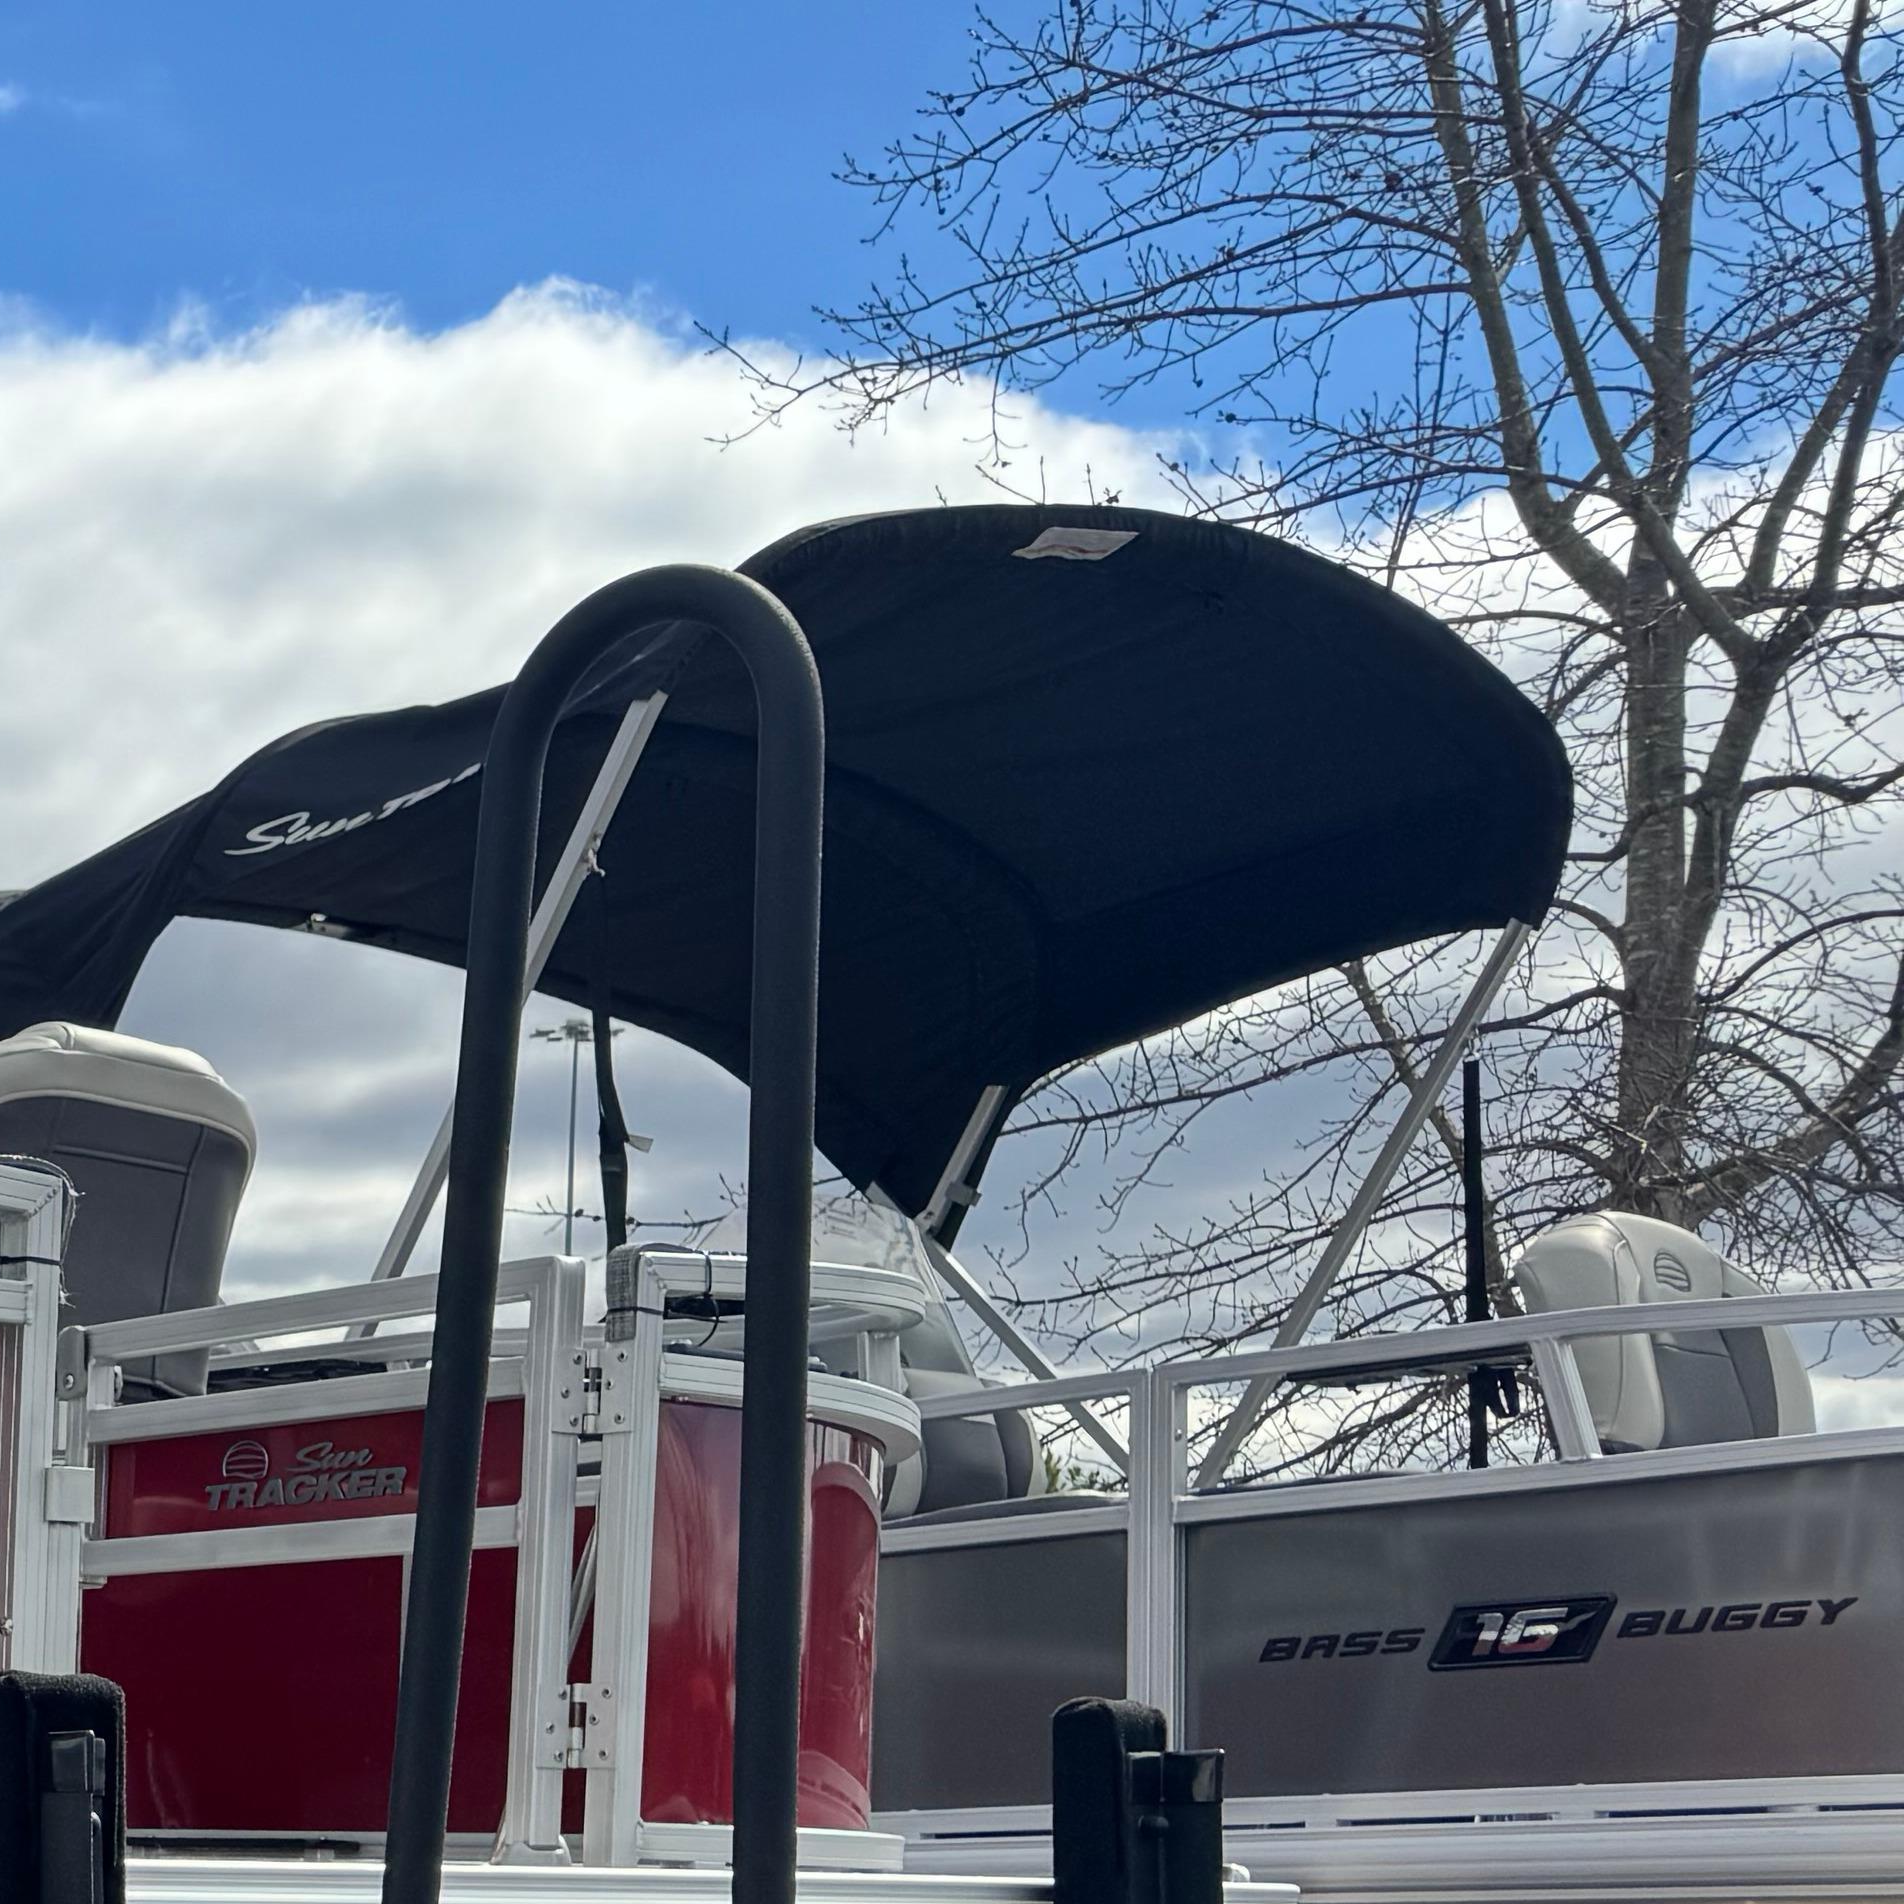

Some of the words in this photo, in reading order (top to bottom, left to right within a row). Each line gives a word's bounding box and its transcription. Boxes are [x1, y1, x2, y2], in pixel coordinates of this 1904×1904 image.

[285, 1441, 373, 1473] Sun
[205, 1466, 408, 1512] TRACKER
[1258, 1628, 1425, 1663] BASS
[1472, 1607, 1569, 1657] 16
[1617, 1597, 1859, 1638] BUGGY
